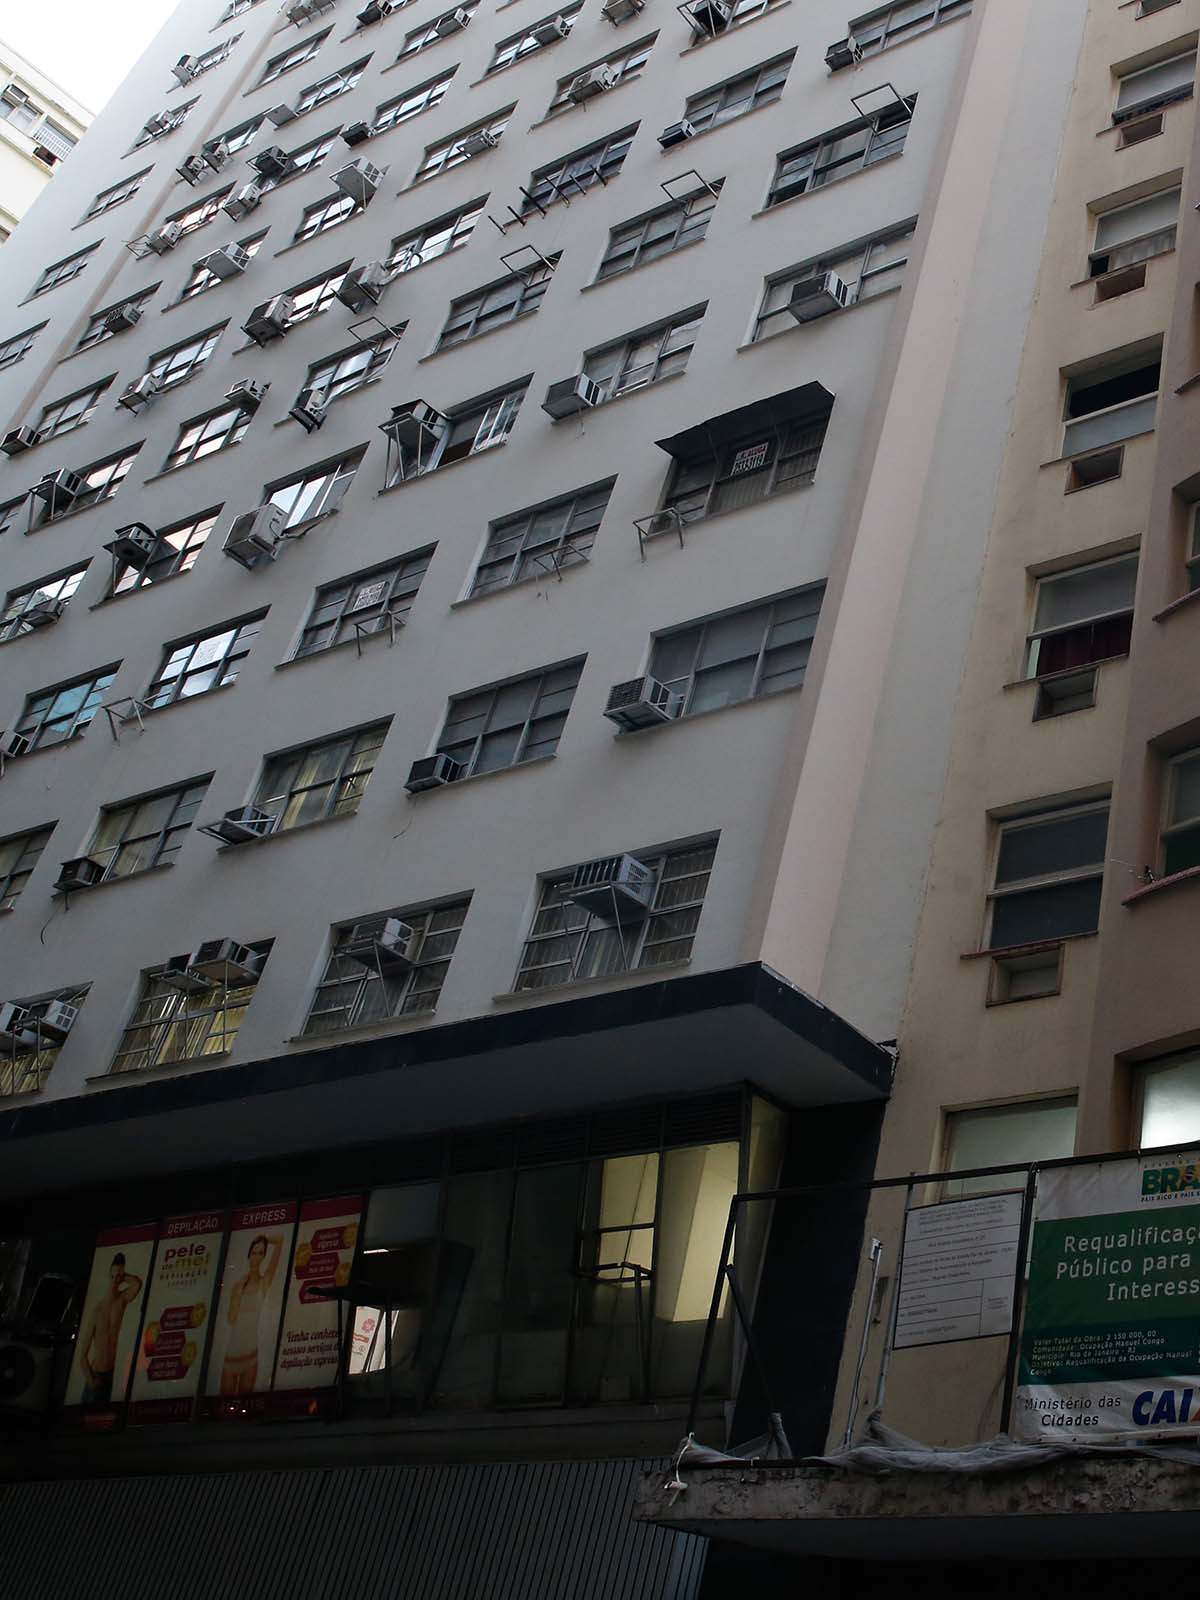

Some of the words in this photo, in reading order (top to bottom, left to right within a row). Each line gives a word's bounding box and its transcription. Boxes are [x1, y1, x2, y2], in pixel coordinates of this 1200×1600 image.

[167, 1215, 219, 1234] DEPILAÇÃO
[242, 1208, 287, 1225] EXPRESS
[165, 1243, 206, 1262] pele
[1056, 1257, 1132, 1280] Público
[1143, 1253, 1191, 1276] para
[1129, 1351, 1164, 1361] Ocupação
[1024, 1395, 1092, 1411] Ministério
[1098, 1394, 1121, 1409] das
[1040, 1413, 1099, 1428] Cidades
